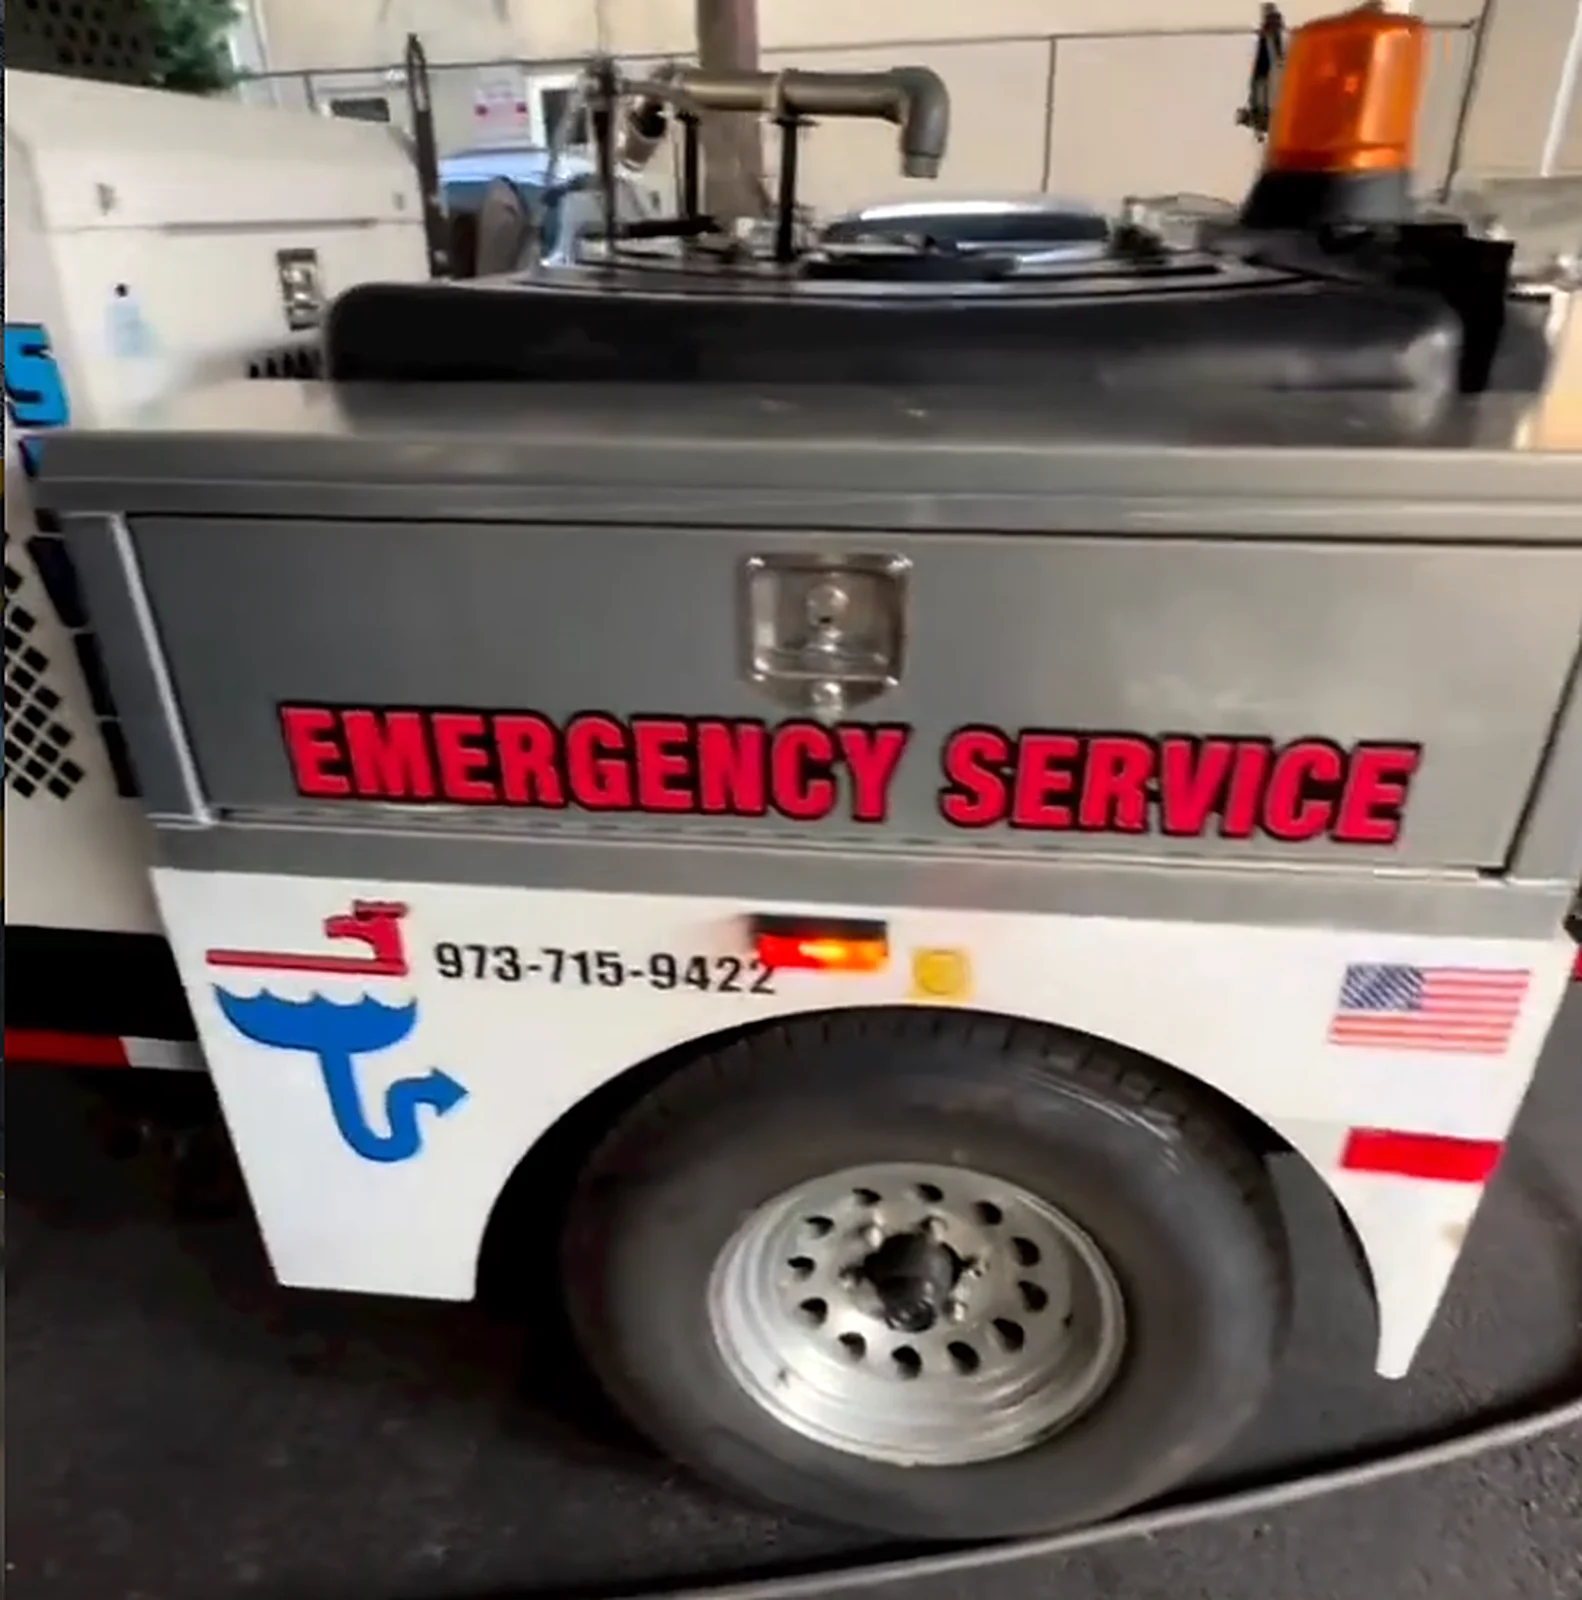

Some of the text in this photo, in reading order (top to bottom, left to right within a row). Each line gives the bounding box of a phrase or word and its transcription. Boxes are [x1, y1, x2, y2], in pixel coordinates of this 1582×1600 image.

[280, 702, 1422, 845] EMERGENCY SERVICE
[435, 942, 776, 995] 973-715-9422
